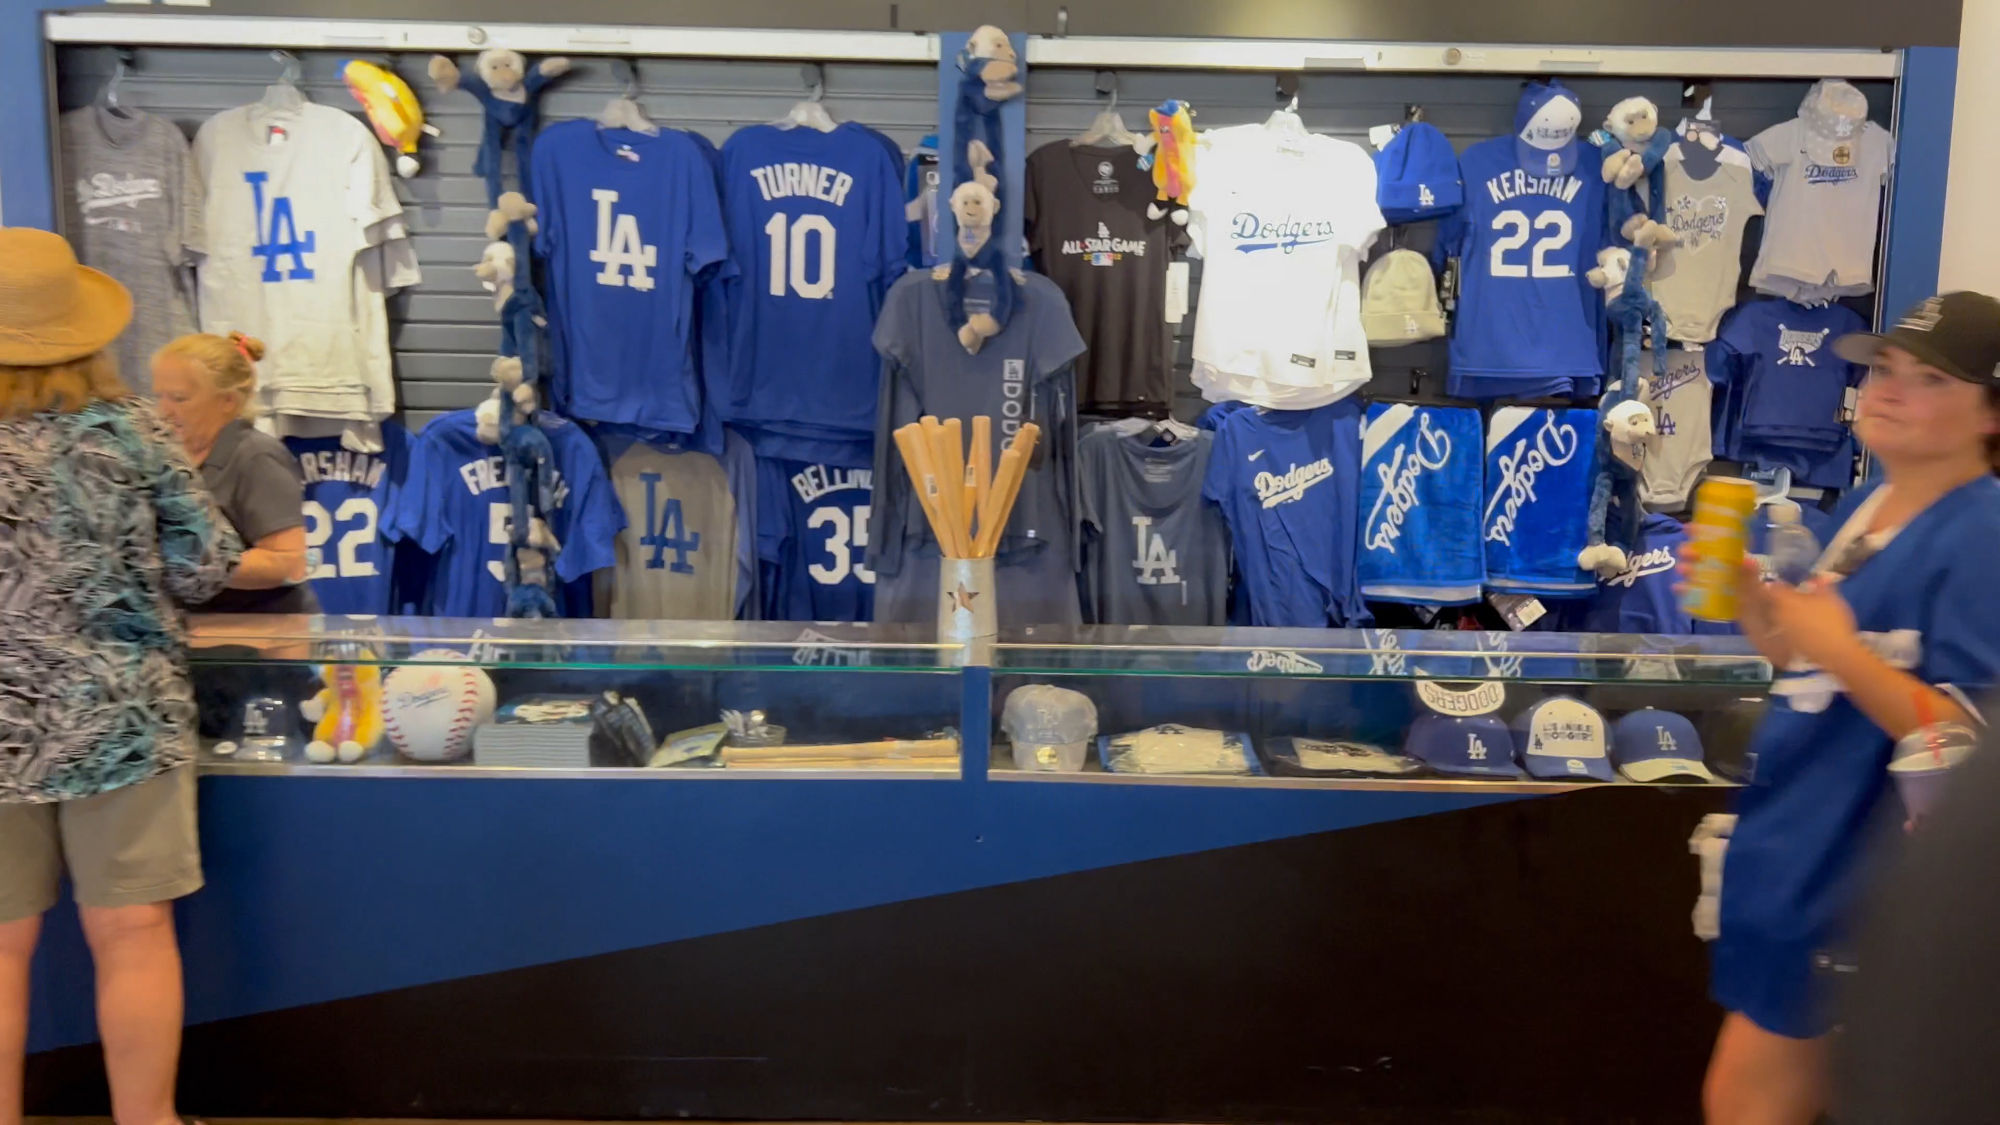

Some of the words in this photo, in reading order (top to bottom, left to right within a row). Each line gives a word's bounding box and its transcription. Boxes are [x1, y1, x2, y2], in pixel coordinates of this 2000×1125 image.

[750, 162, 853, 206] TURNER
[244, 171, 315, 282] LA
[589, 189, 657, 292] LA
[764, 211, 837, 299] 10
[1112, 237, 1146, 256] GAME
[1231, 212, 1334, 254] Dodgers
[1490, 209, 1575, 277] 22
[1649, 360, 1700, 400] odgers
[1655, 405, 1676, 435] LA
[1254, 457, 1334, 509] Dodgers
[1365, 412, 1451, 554] Dodgers
[1483, 408, 1578, 547] Dodgers
[639, 472, 699, 574] LA
[807, 505, 876, 585] 35
[1132, 516, 1181, 584] LA
[1424, 683, 1498, 712] DODGERS
[1467, 733, 1488, 759] LA
[1656, 726, 1677, 750] LA
